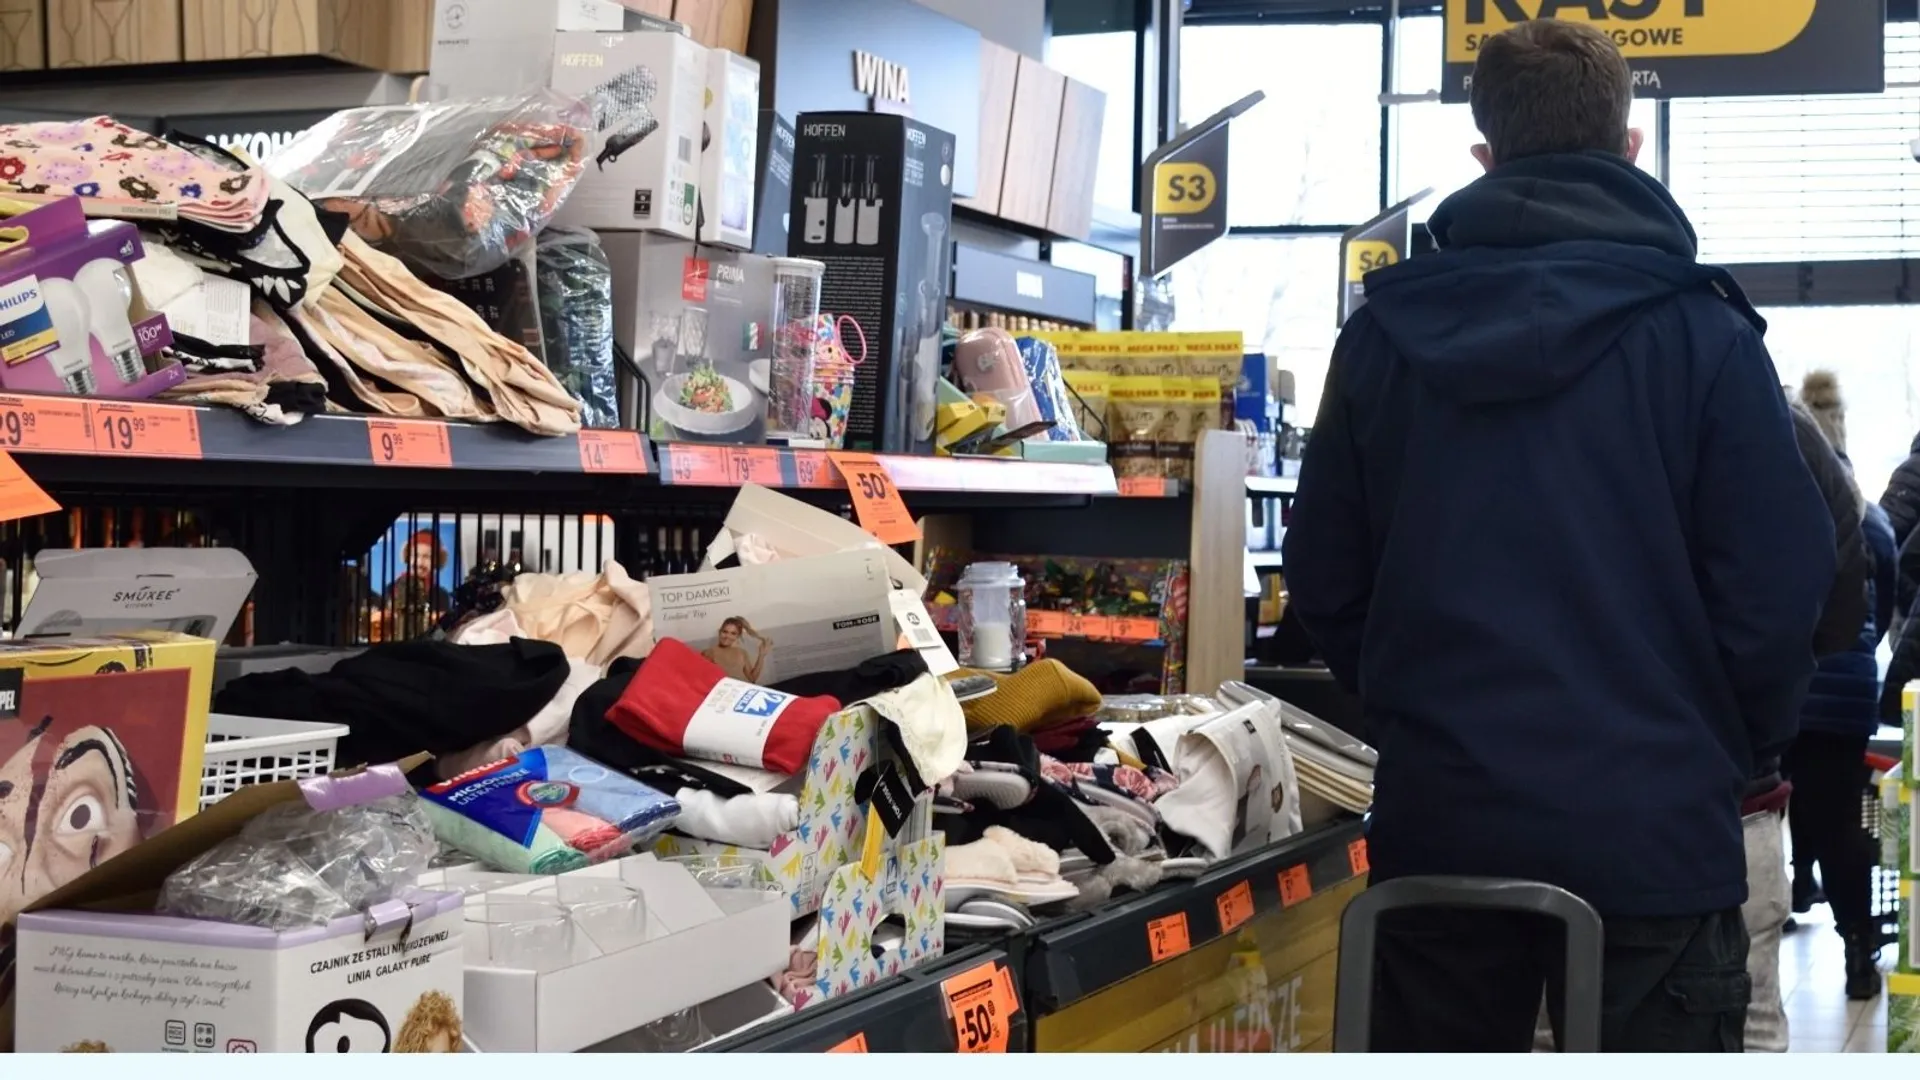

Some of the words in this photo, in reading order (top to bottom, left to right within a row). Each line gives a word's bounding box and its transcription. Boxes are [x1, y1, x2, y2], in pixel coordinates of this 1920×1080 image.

[561, 53, 604, 67] HOFFEN
[853, 50, 910, 103] WINA
[804, 124, 846, 138] HOFFEN
[1168, 174, 1206, 202] S3
[1359, 250, 1389, 271] S4
[716, 264, 745, 284] PRIMA
[0, 288, 38, 310] HILIPS
[103, 415, 132, 449] 19
[382, 432, 393, 461] 9
[661, 592, 683, 603] TOP
[686, 586, 730, 601] DAMSKI
[310, 955, 350, 974] CZAJNIK
[352, 951, 364, 965] ZE
[366, 946, 390, 961] STALI
[347, 969, 371, 984] LINIA
[375, 958, 409, 977] GALAXY
[411, 953, 431, 968] PURE
